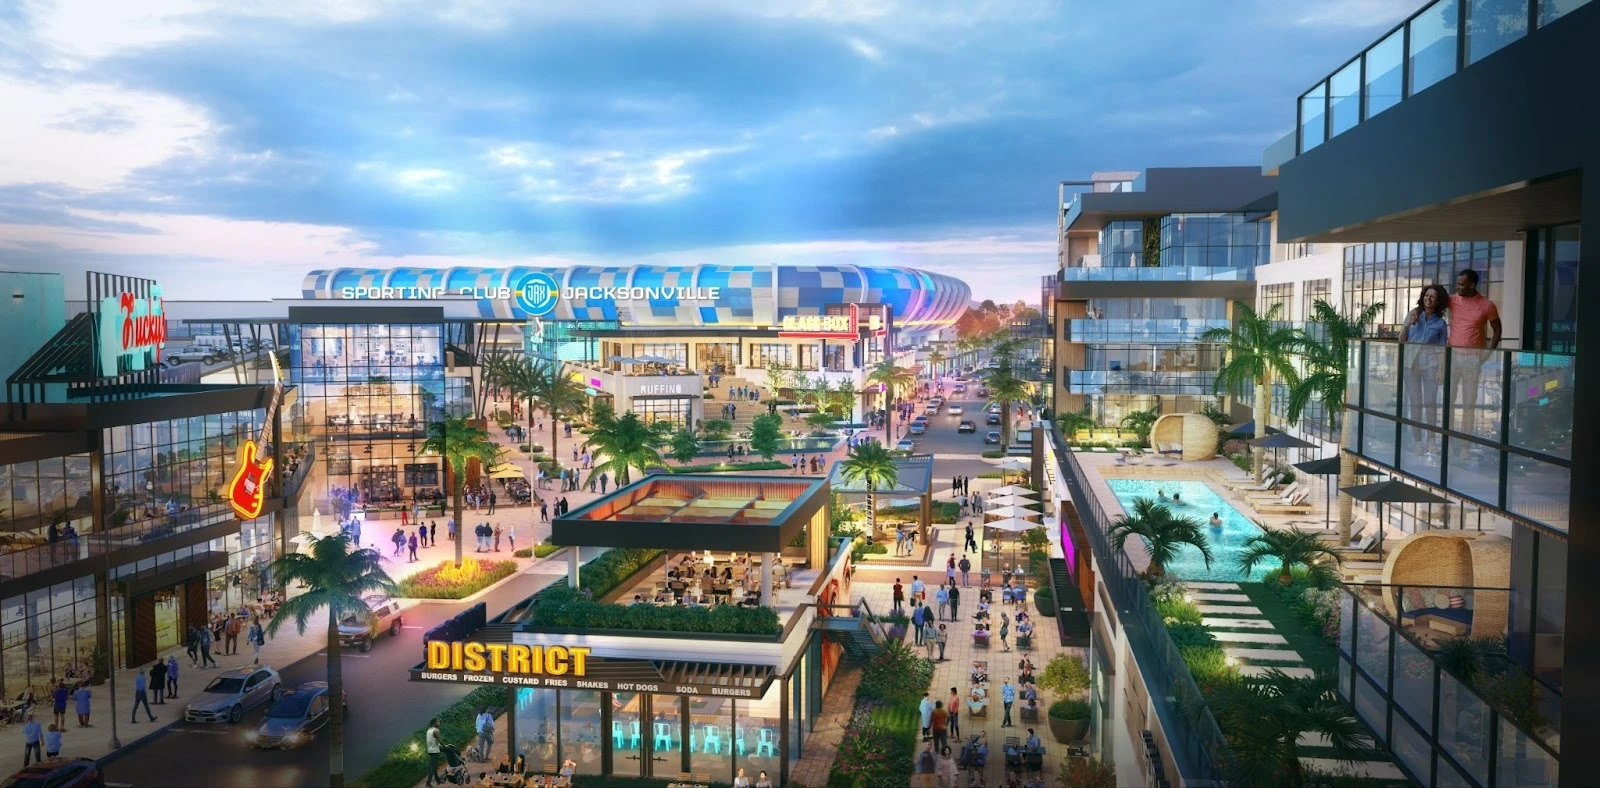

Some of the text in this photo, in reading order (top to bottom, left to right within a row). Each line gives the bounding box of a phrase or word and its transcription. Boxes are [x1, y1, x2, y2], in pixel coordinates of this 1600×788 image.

[342, 286, 721, 300] SPORTING CLUB JACKSONVILLE
[527, 284, 546, 304] JAX
[823, 315, 850, 331] BOX
[427, 640, 592, 677] DISTRICT
[421, 672, 458, 681] BURGERS
[463, 674, 494, 683] FROZEN
[502, 677, 539, 685] CUSTARD
[545, 679, 568, 687] FRIES
[576, 680, 609, 689] SHAKES
[636, 684, 659, 692] DOGS
[675, 686, 699, 694] SODA
[711, 688, 751, 697] BURGERS
